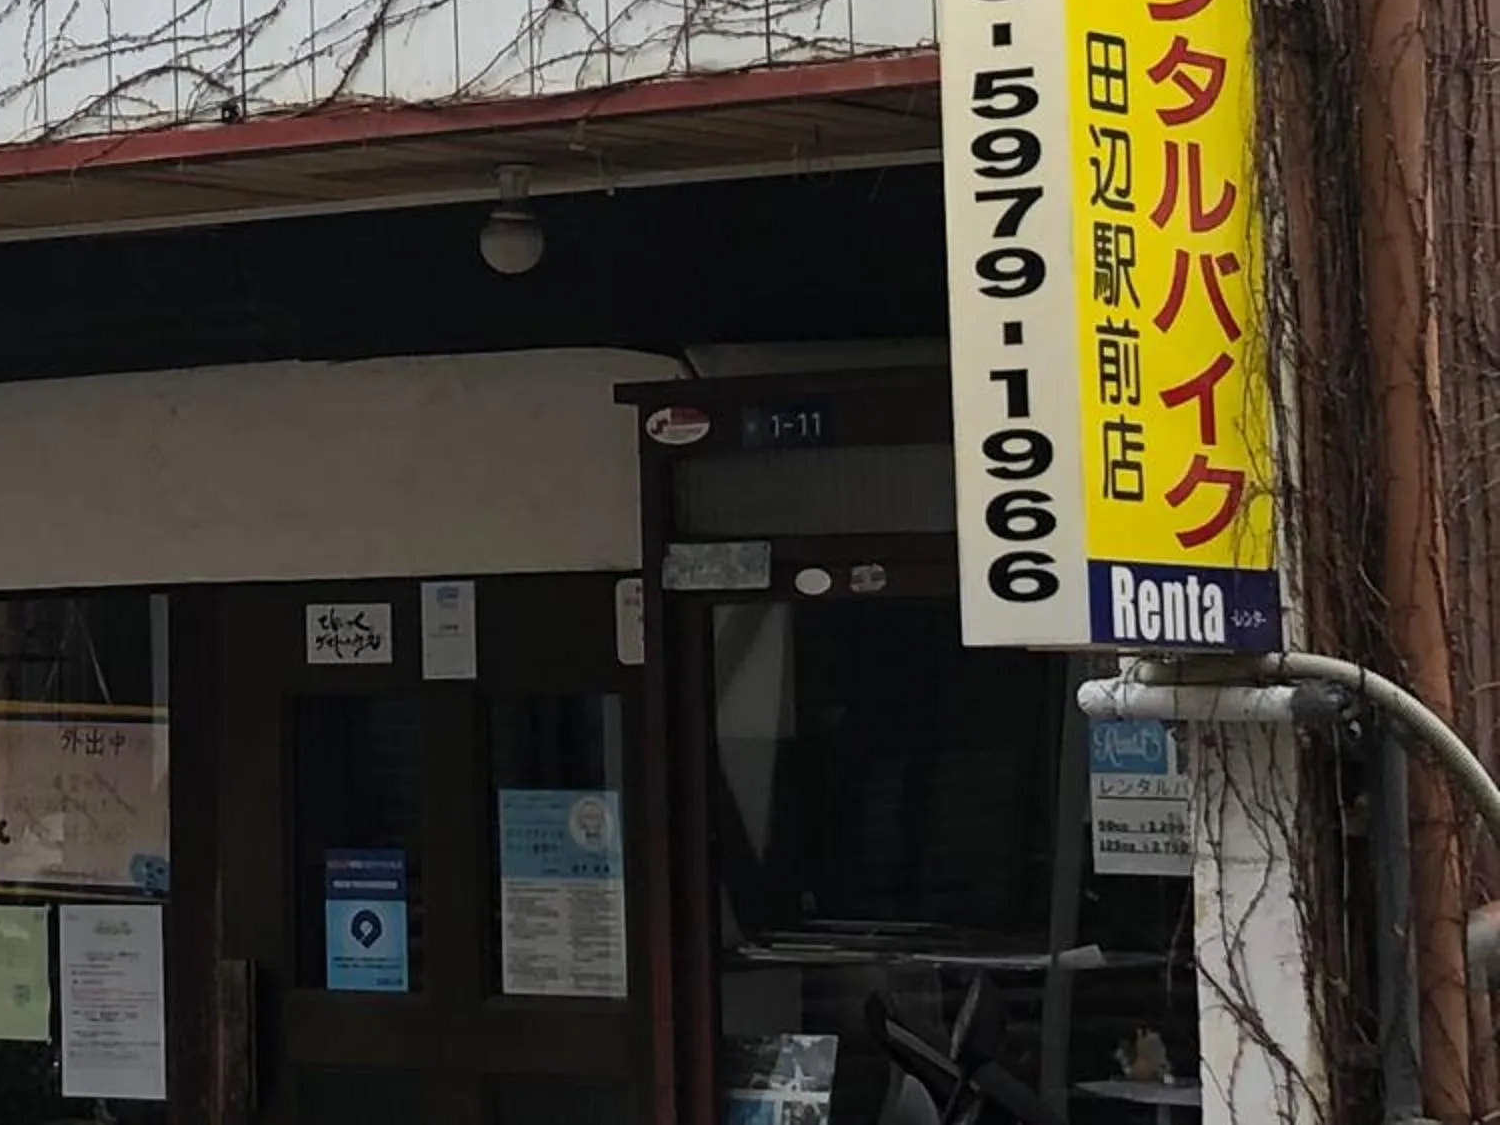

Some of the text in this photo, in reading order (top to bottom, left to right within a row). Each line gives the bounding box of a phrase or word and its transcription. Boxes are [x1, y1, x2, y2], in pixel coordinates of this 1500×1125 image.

[1086, 31, 1146, 503] 田辺駅前店
[771, 412, 821, 438] 1-11
[1111, 565, 1225, 643] Renta
[61, 729, 127, 756] 外出中
